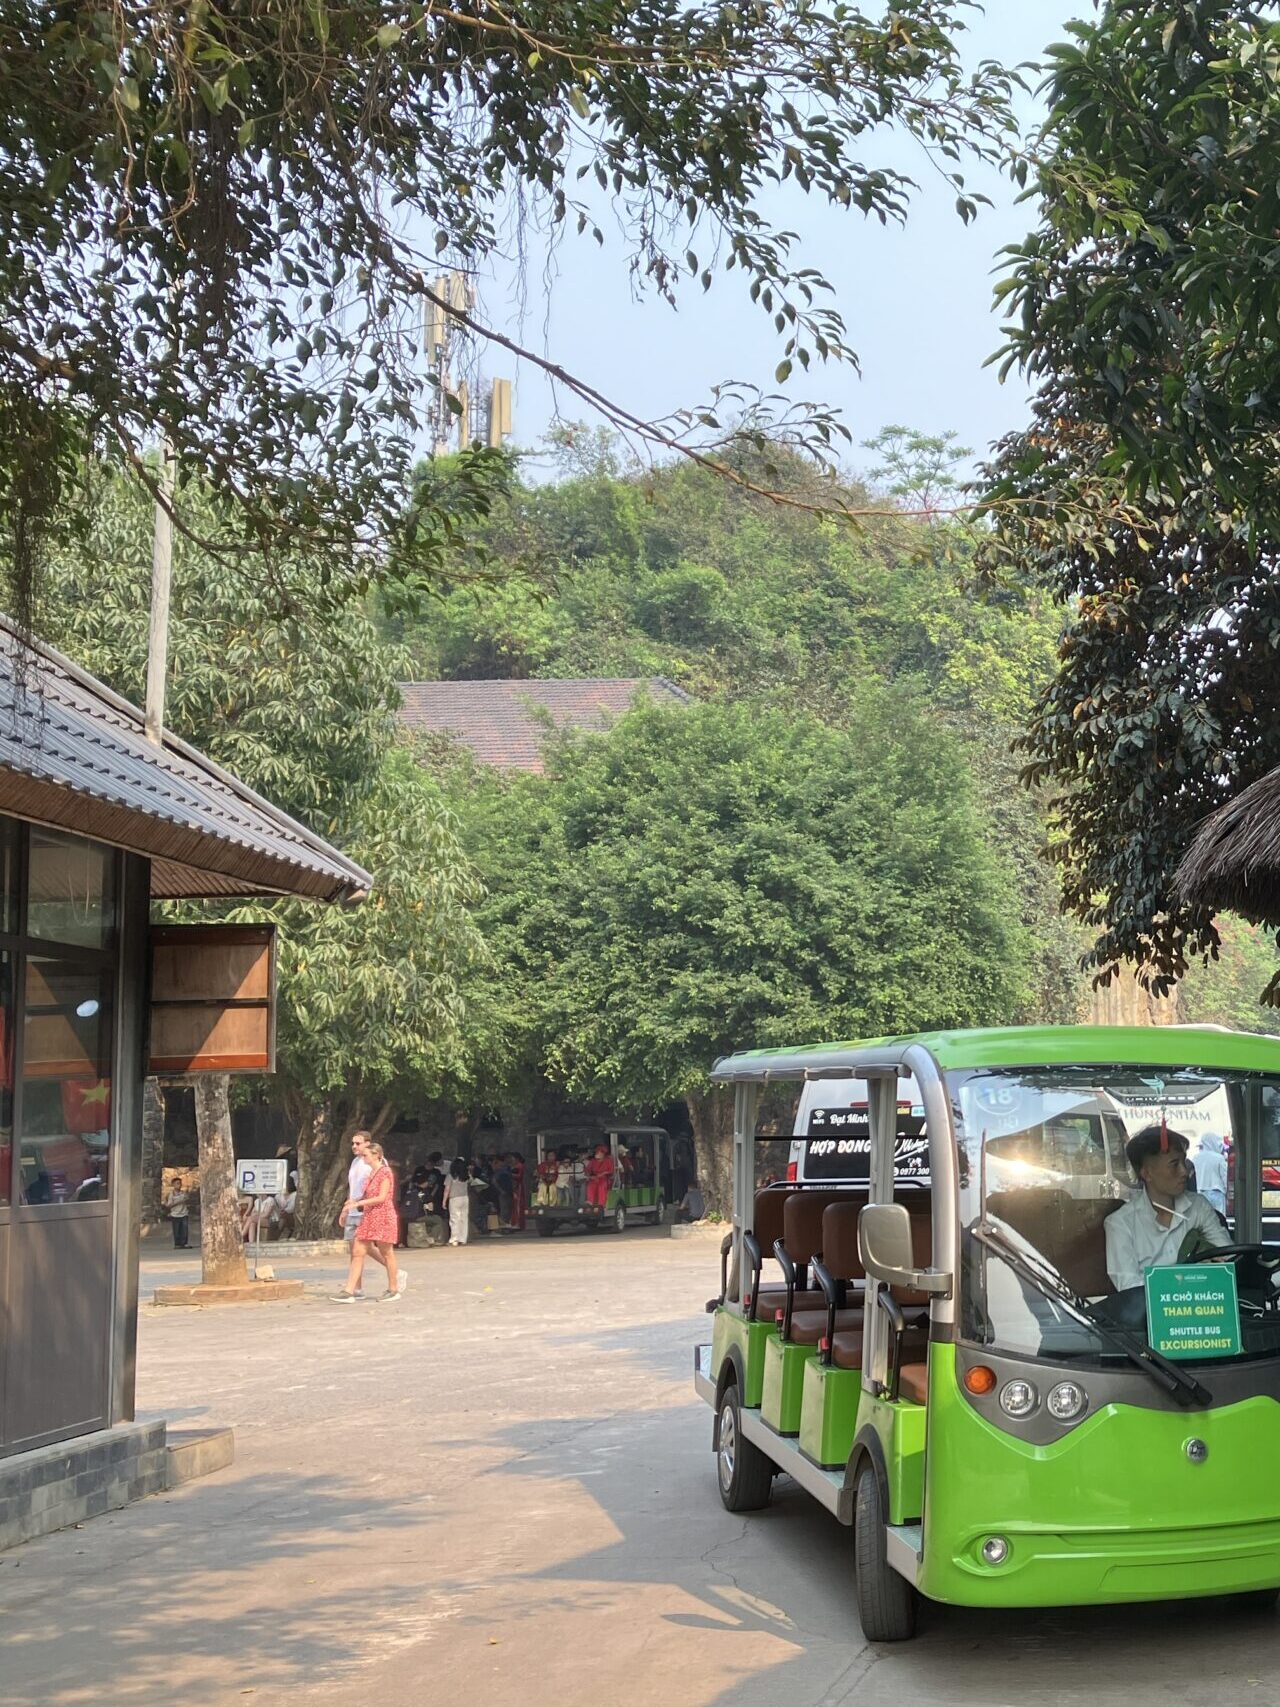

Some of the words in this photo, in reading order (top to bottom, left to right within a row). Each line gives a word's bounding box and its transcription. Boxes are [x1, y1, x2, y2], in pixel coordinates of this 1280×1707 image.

[1160, 1294, 1171, 1302] XE
[1172, 1291, 1193, 1301] CHỞ
[1194, 1291, 1224, 1301] KHÁCH
[1163, 1306, 1193, 1317] THAM
[1194, 1306, 1224, 1316] QUAN
[1169, 1327, 1203, 1336] SHUTTLE
[1204, 1326, 1221, 1335] BUS
[1160, 1339, 1232, 1350] EXCURSIONIST
